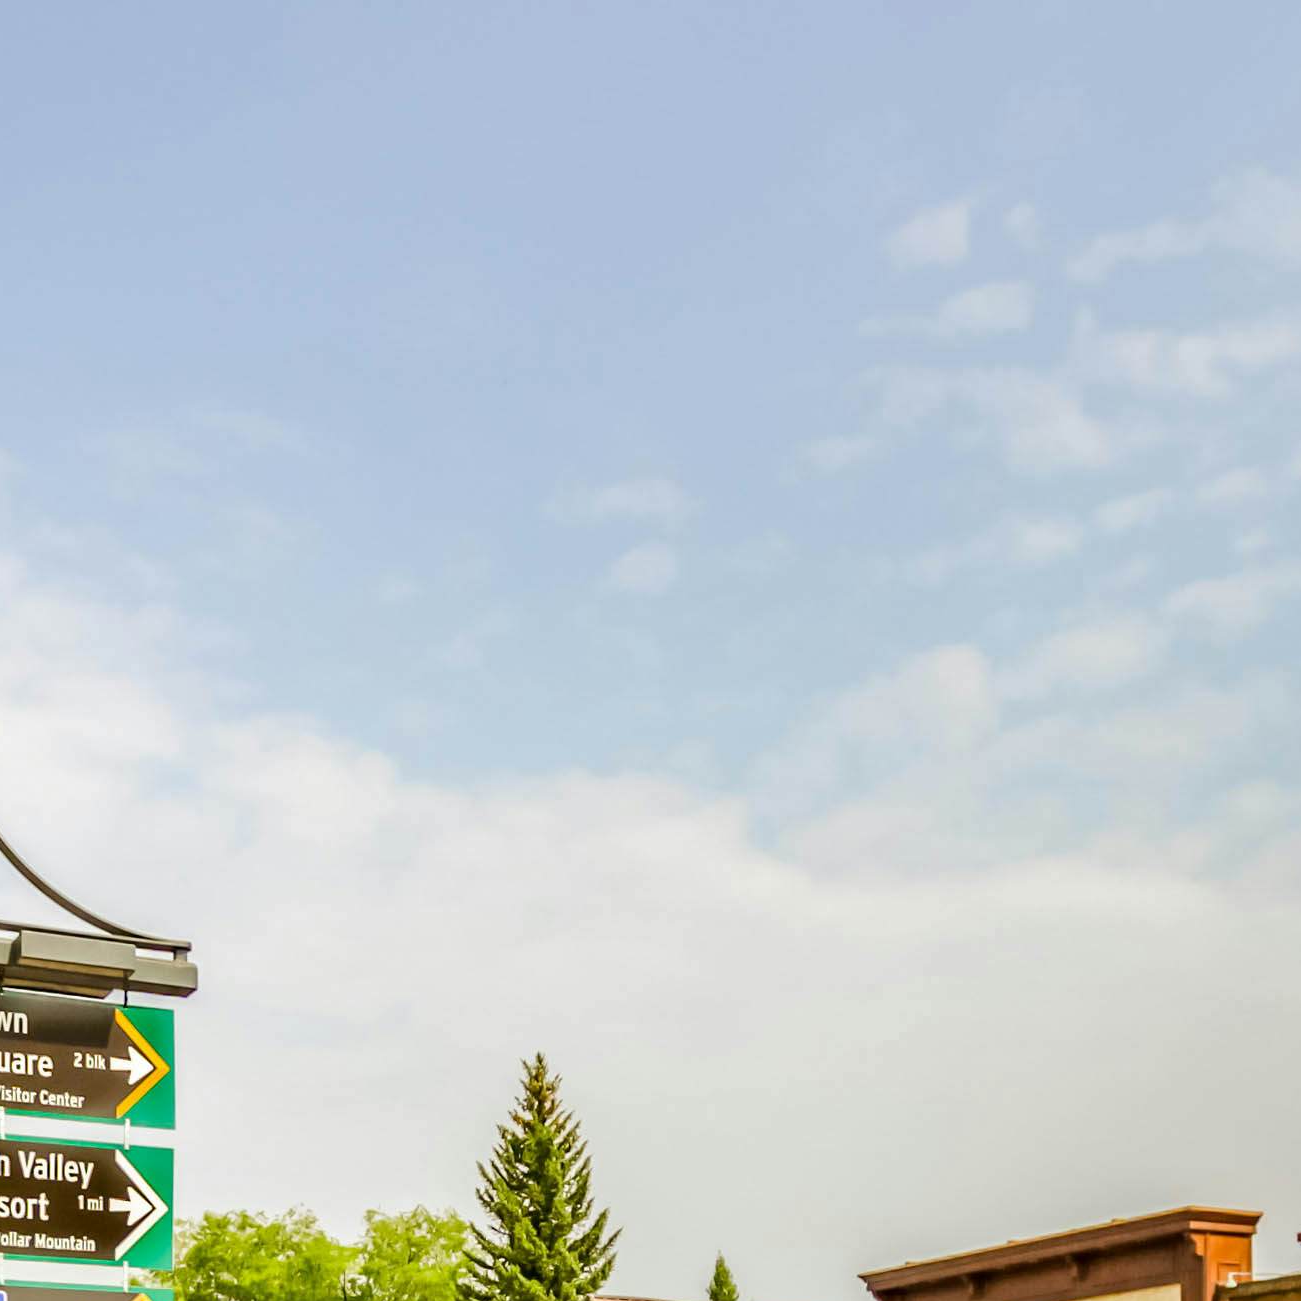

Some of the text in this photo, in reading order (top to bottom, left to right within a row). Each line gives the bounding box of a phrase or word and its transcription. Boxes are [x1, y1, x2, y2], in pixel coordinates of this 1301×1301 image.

[73, 1052, 106, 1070] 2 blk
[39, 1089, 85, 1109] Center
[18, 1150, 94, 1189] Valley
[78, 1195, 104, 1211] 1 mi
[34, 1233, 96, 1252] Mountain
